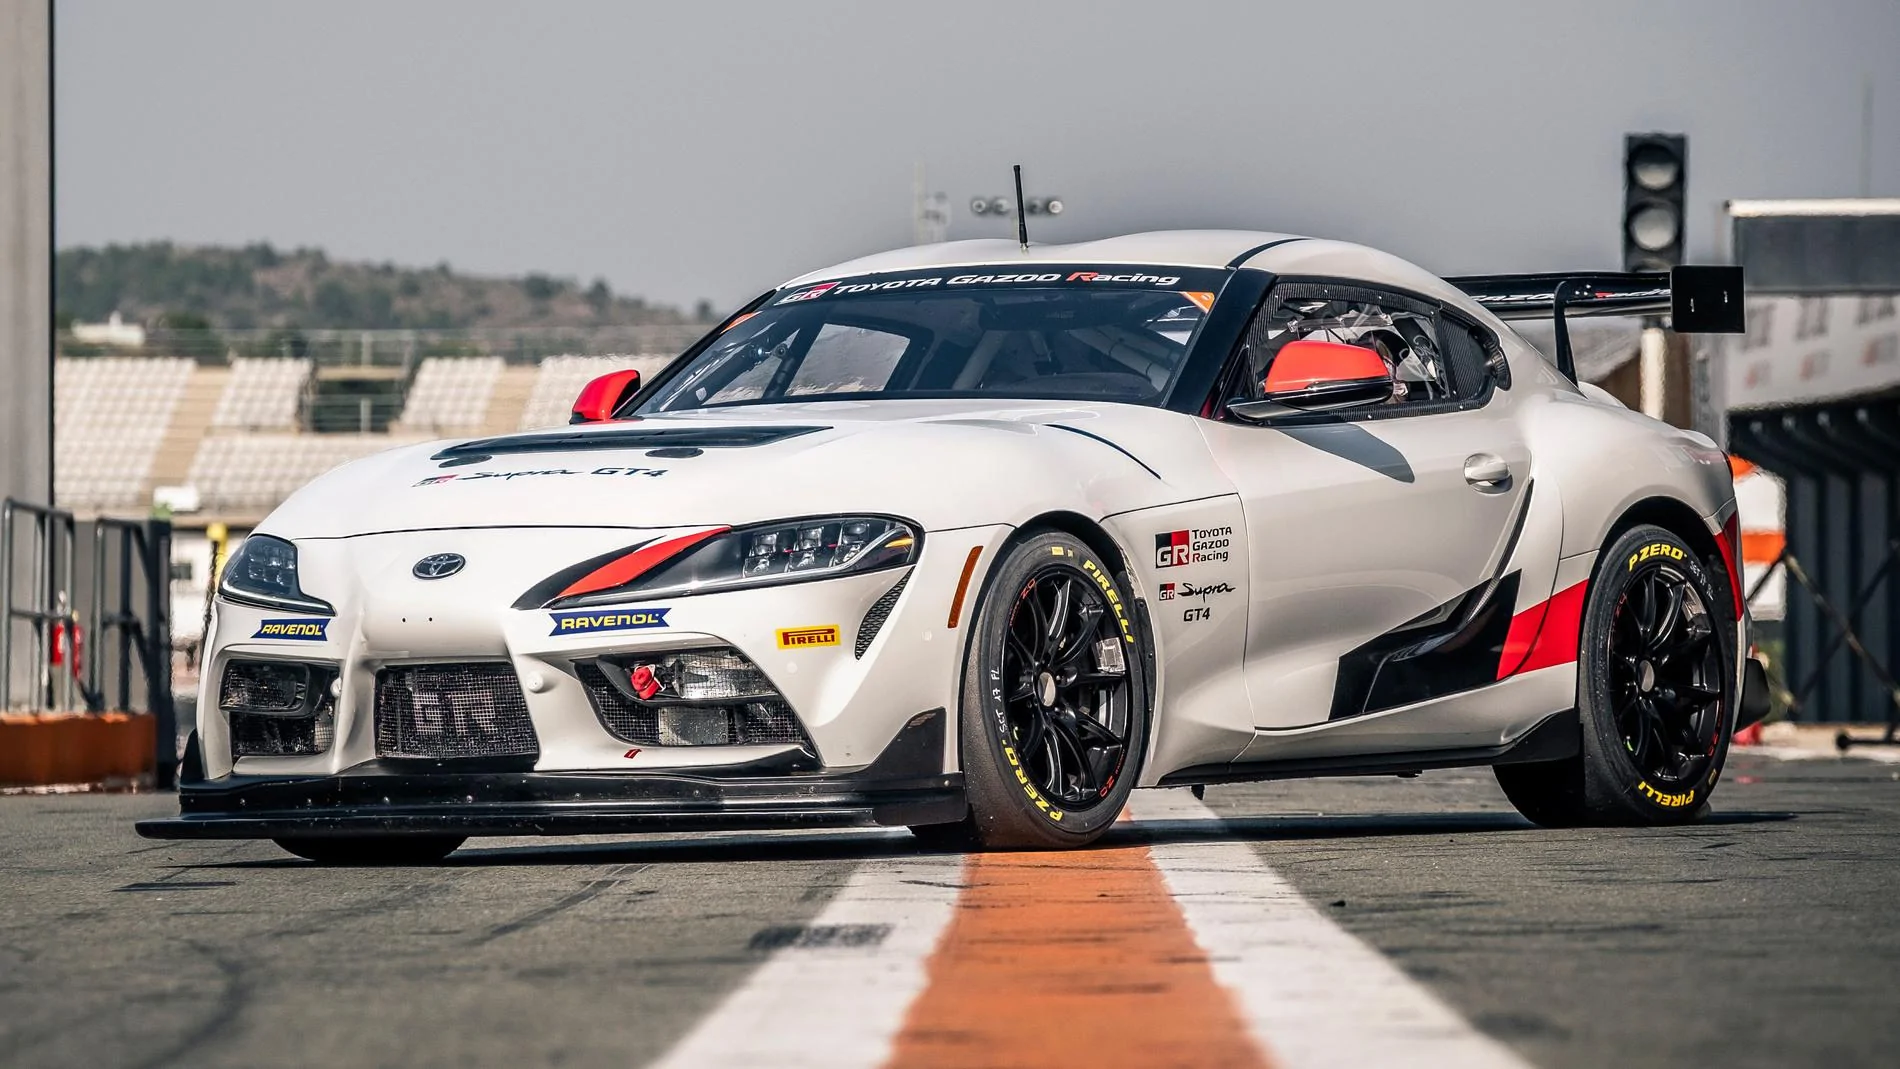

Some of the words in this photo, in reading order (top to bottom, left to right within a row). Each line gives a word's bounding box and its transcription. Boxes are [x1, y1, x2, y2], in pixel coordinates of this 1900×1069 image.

[833, 277, 943, 295] TOYOTA
[946, 273, 1062, 285] GAZOO
[1065, 271, 1181, 286] Racing
[456, 468, 583, 481] Supra
[590, 467, 669, 477] GT4
[1191, 526, 1232, 540] TOYOTA
[1156, 543, 1189, 568] GR
[1192, 538, 1230, 551] GAZOO
[1192, 551, 1229, 563] Racing
[1083, 559, 1134, 643] PIRELLI
[1159, 588, 1175, 600] GR
[1177, 582, 1237, 603] Supra
[561, 613, 660, 630] RAVENOL
[1183, 607, 1211, 622] GT4
[261, 623, 323, 636] RAVENOL
[782, 628, 836, 646] PIRELLI
[412, 689, 499, 735] GR
[1638, 781, 1695, 807] PIRELLI
